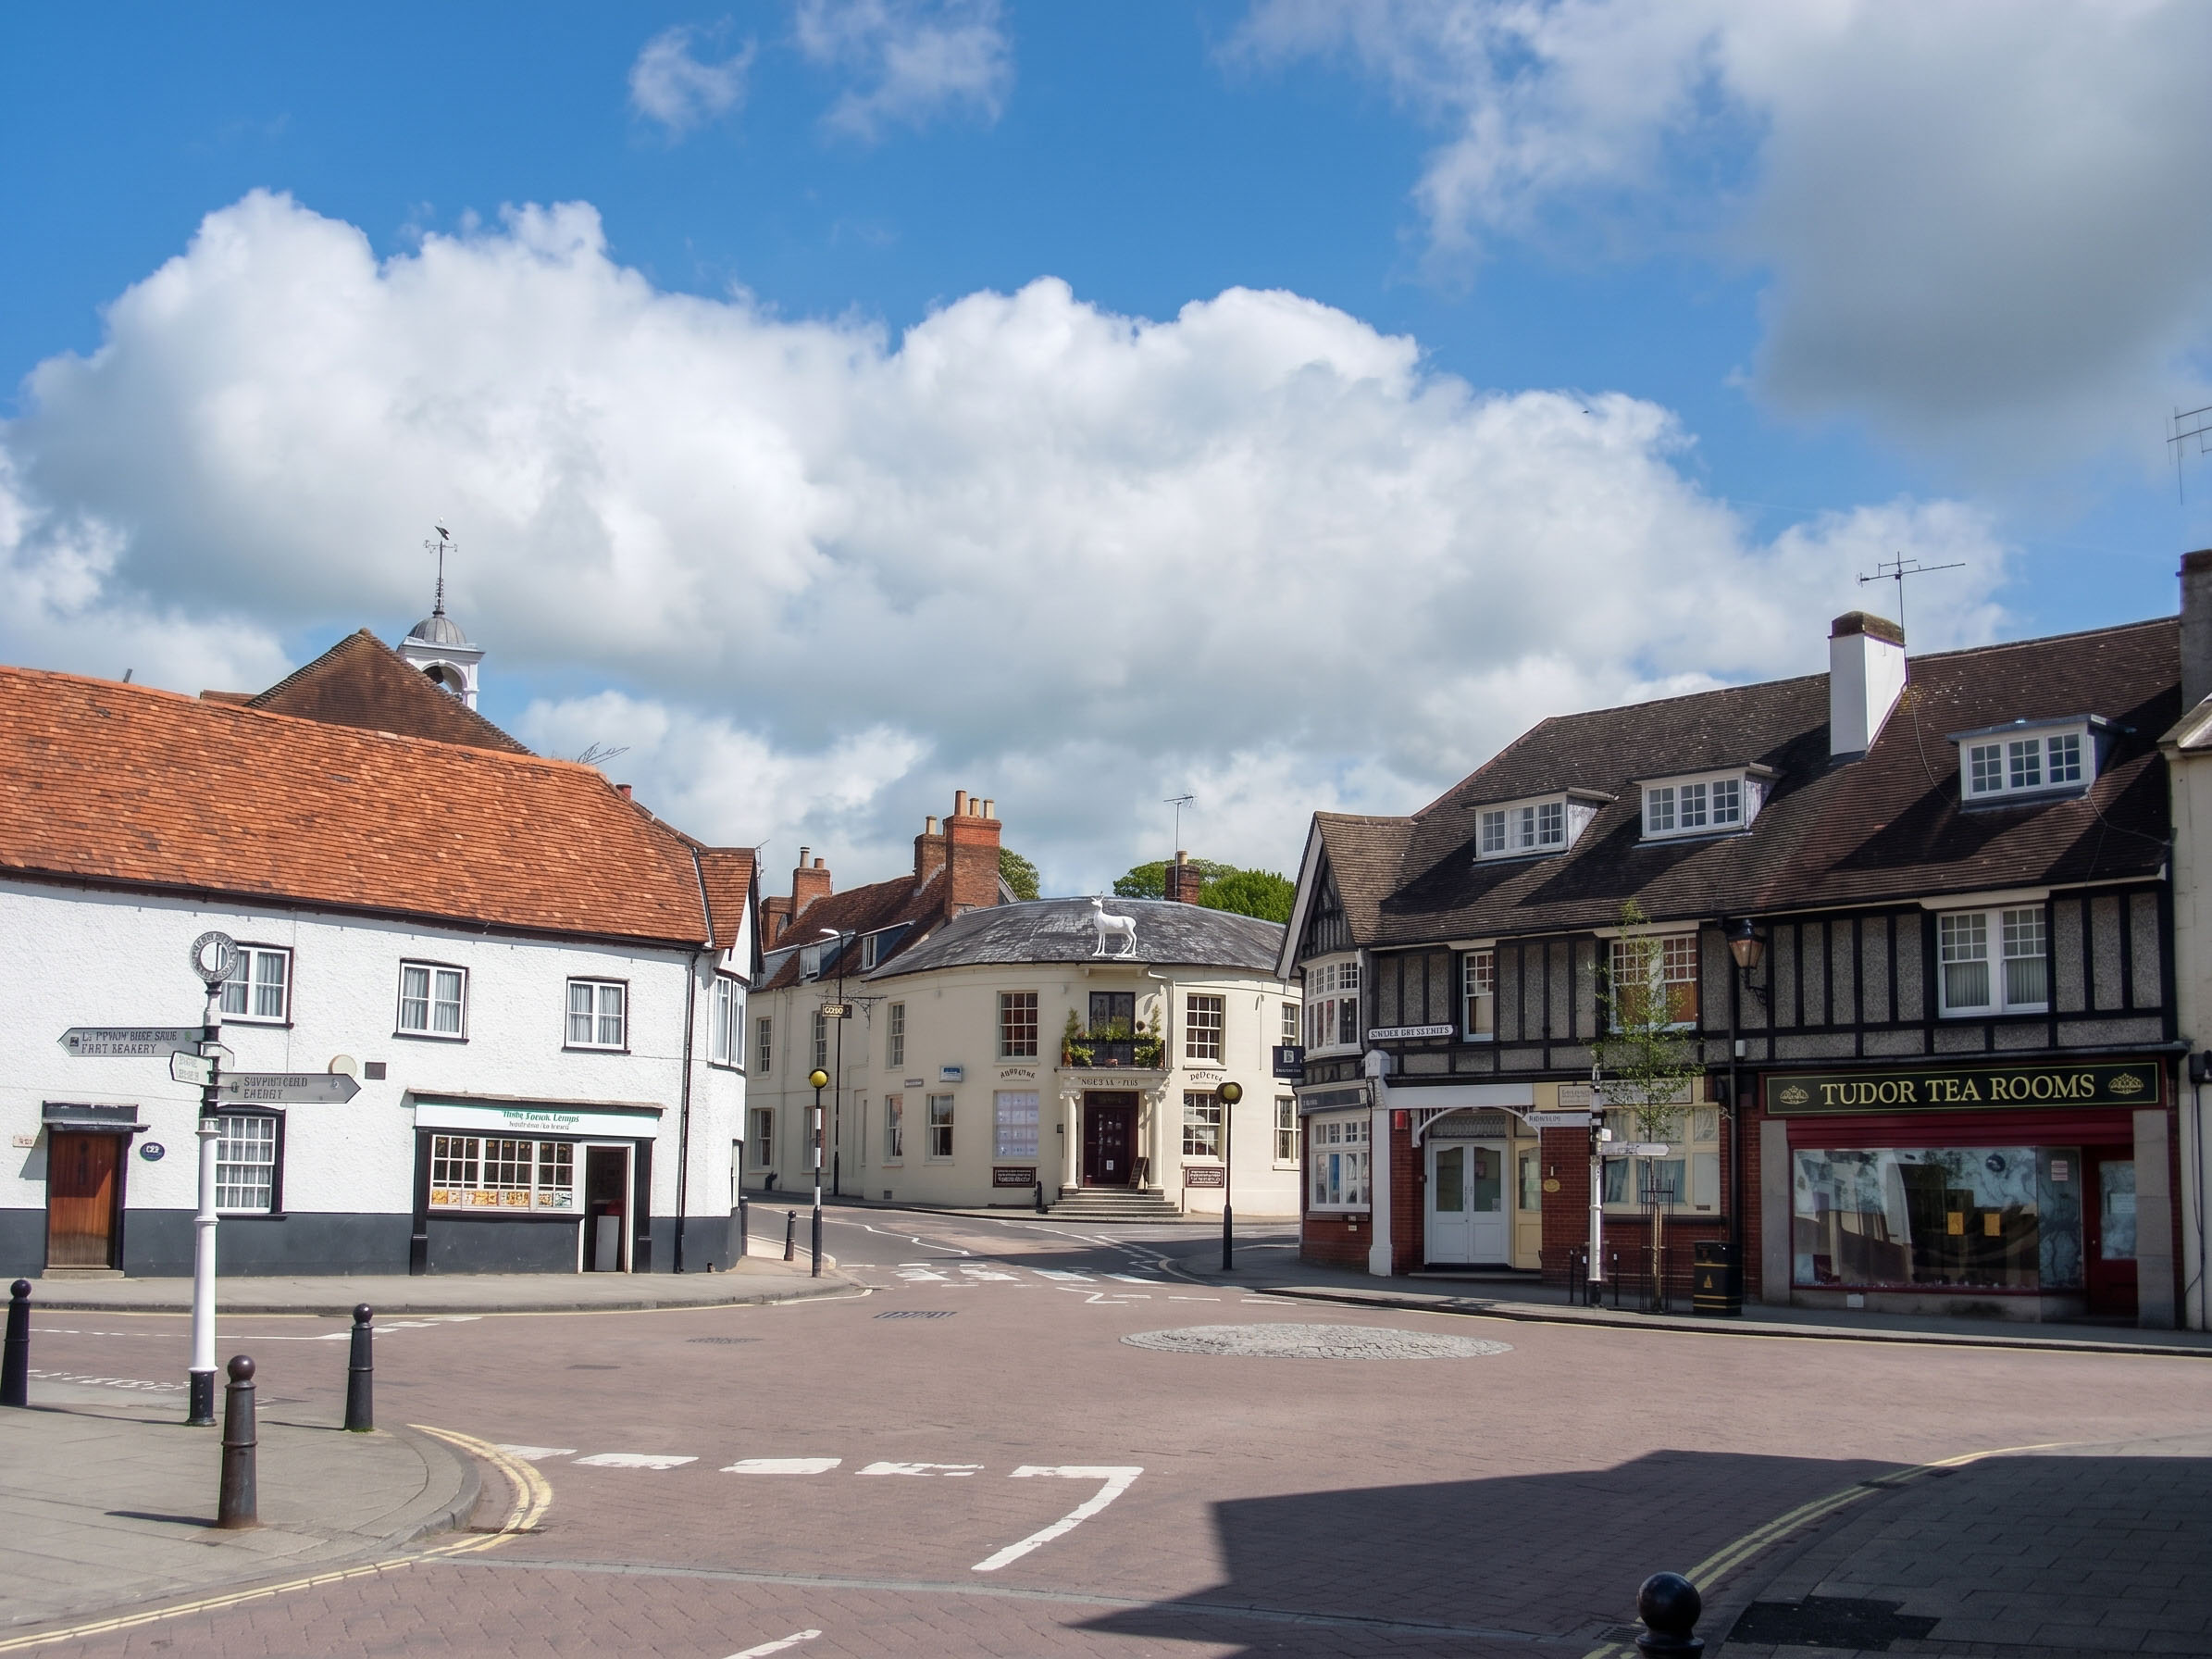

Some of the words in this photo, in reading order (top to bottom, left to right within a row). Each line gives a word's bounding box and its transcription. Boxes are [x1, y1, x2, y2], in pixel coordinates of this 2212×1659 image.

[1821, 1081, 1918, 1105] TUDOR
[1925, 1079, 1982, 1103] TEA
[1989, 1074, 2095, 1101] ROOMS
